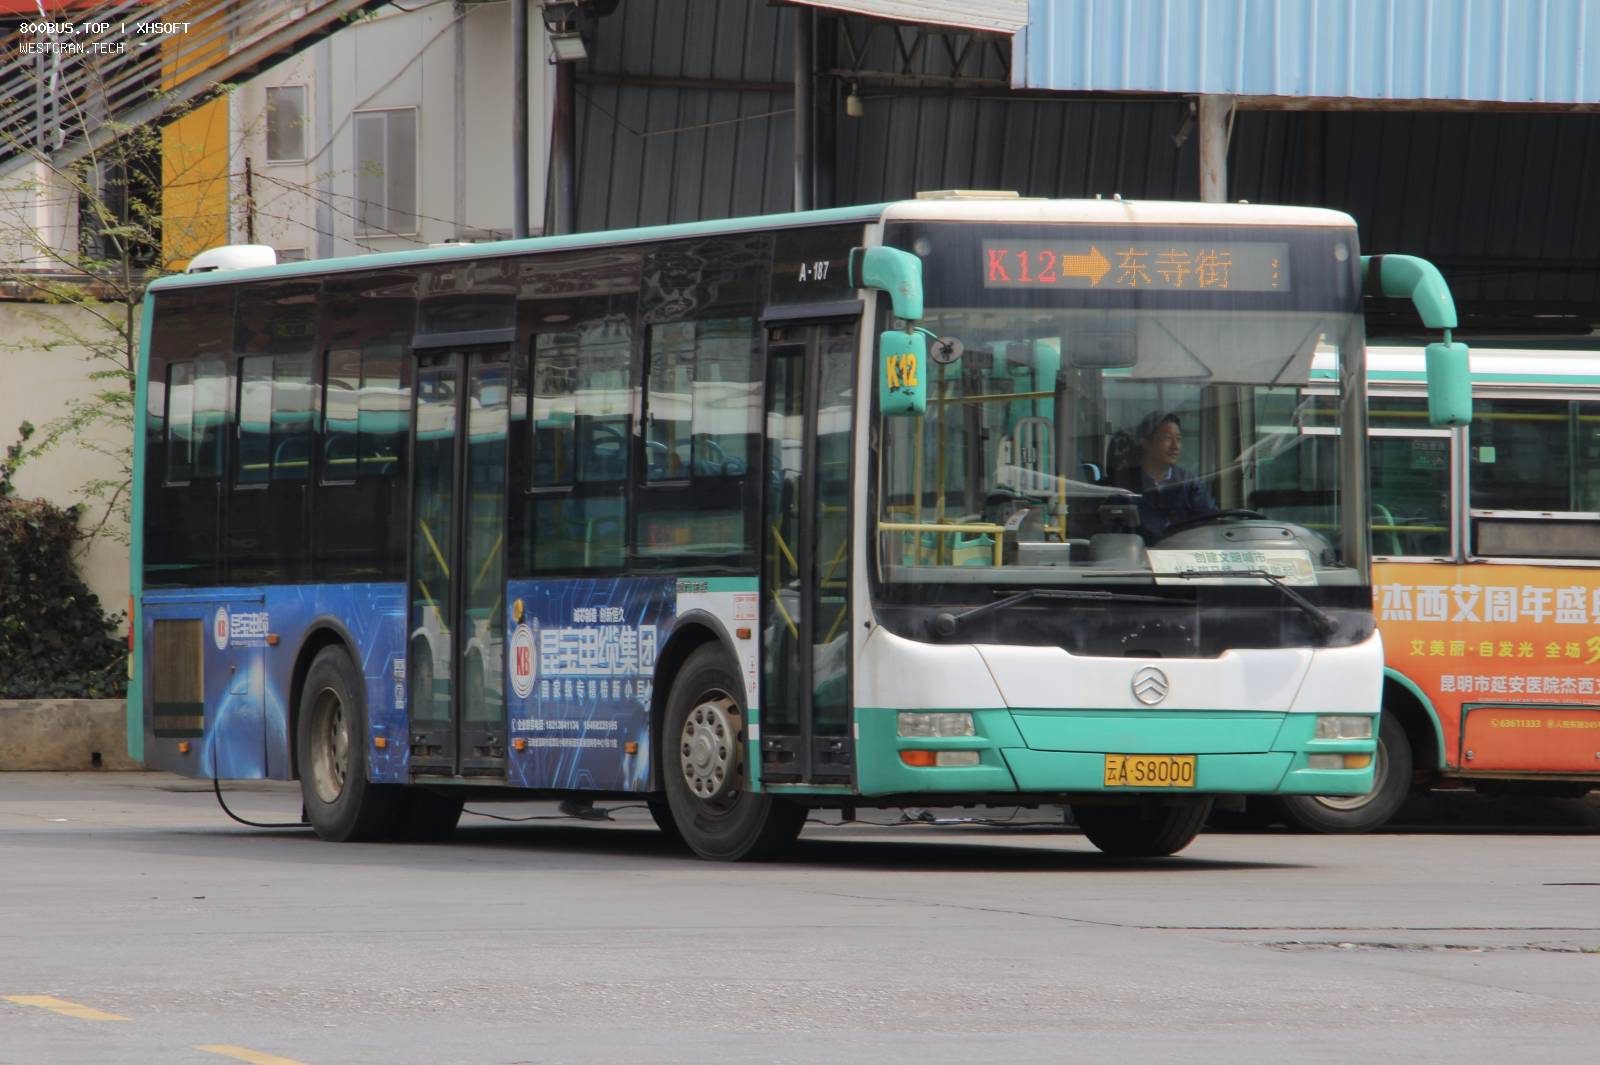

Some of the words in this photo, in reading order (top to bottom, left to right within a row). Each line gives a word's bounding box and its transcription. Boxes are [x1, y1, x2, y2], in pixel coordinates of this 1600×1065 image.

[988, 249, 1057, 282] K12
[1114, 247, 1233, 288] 东寺街
[886, 353, 918, 388] K12
[1375, 583, 1600, 624] 杰西艾周年盛
[516, 646, 530, 676] KB
[541, 625, 657, 675] 昆宝电缆集团
